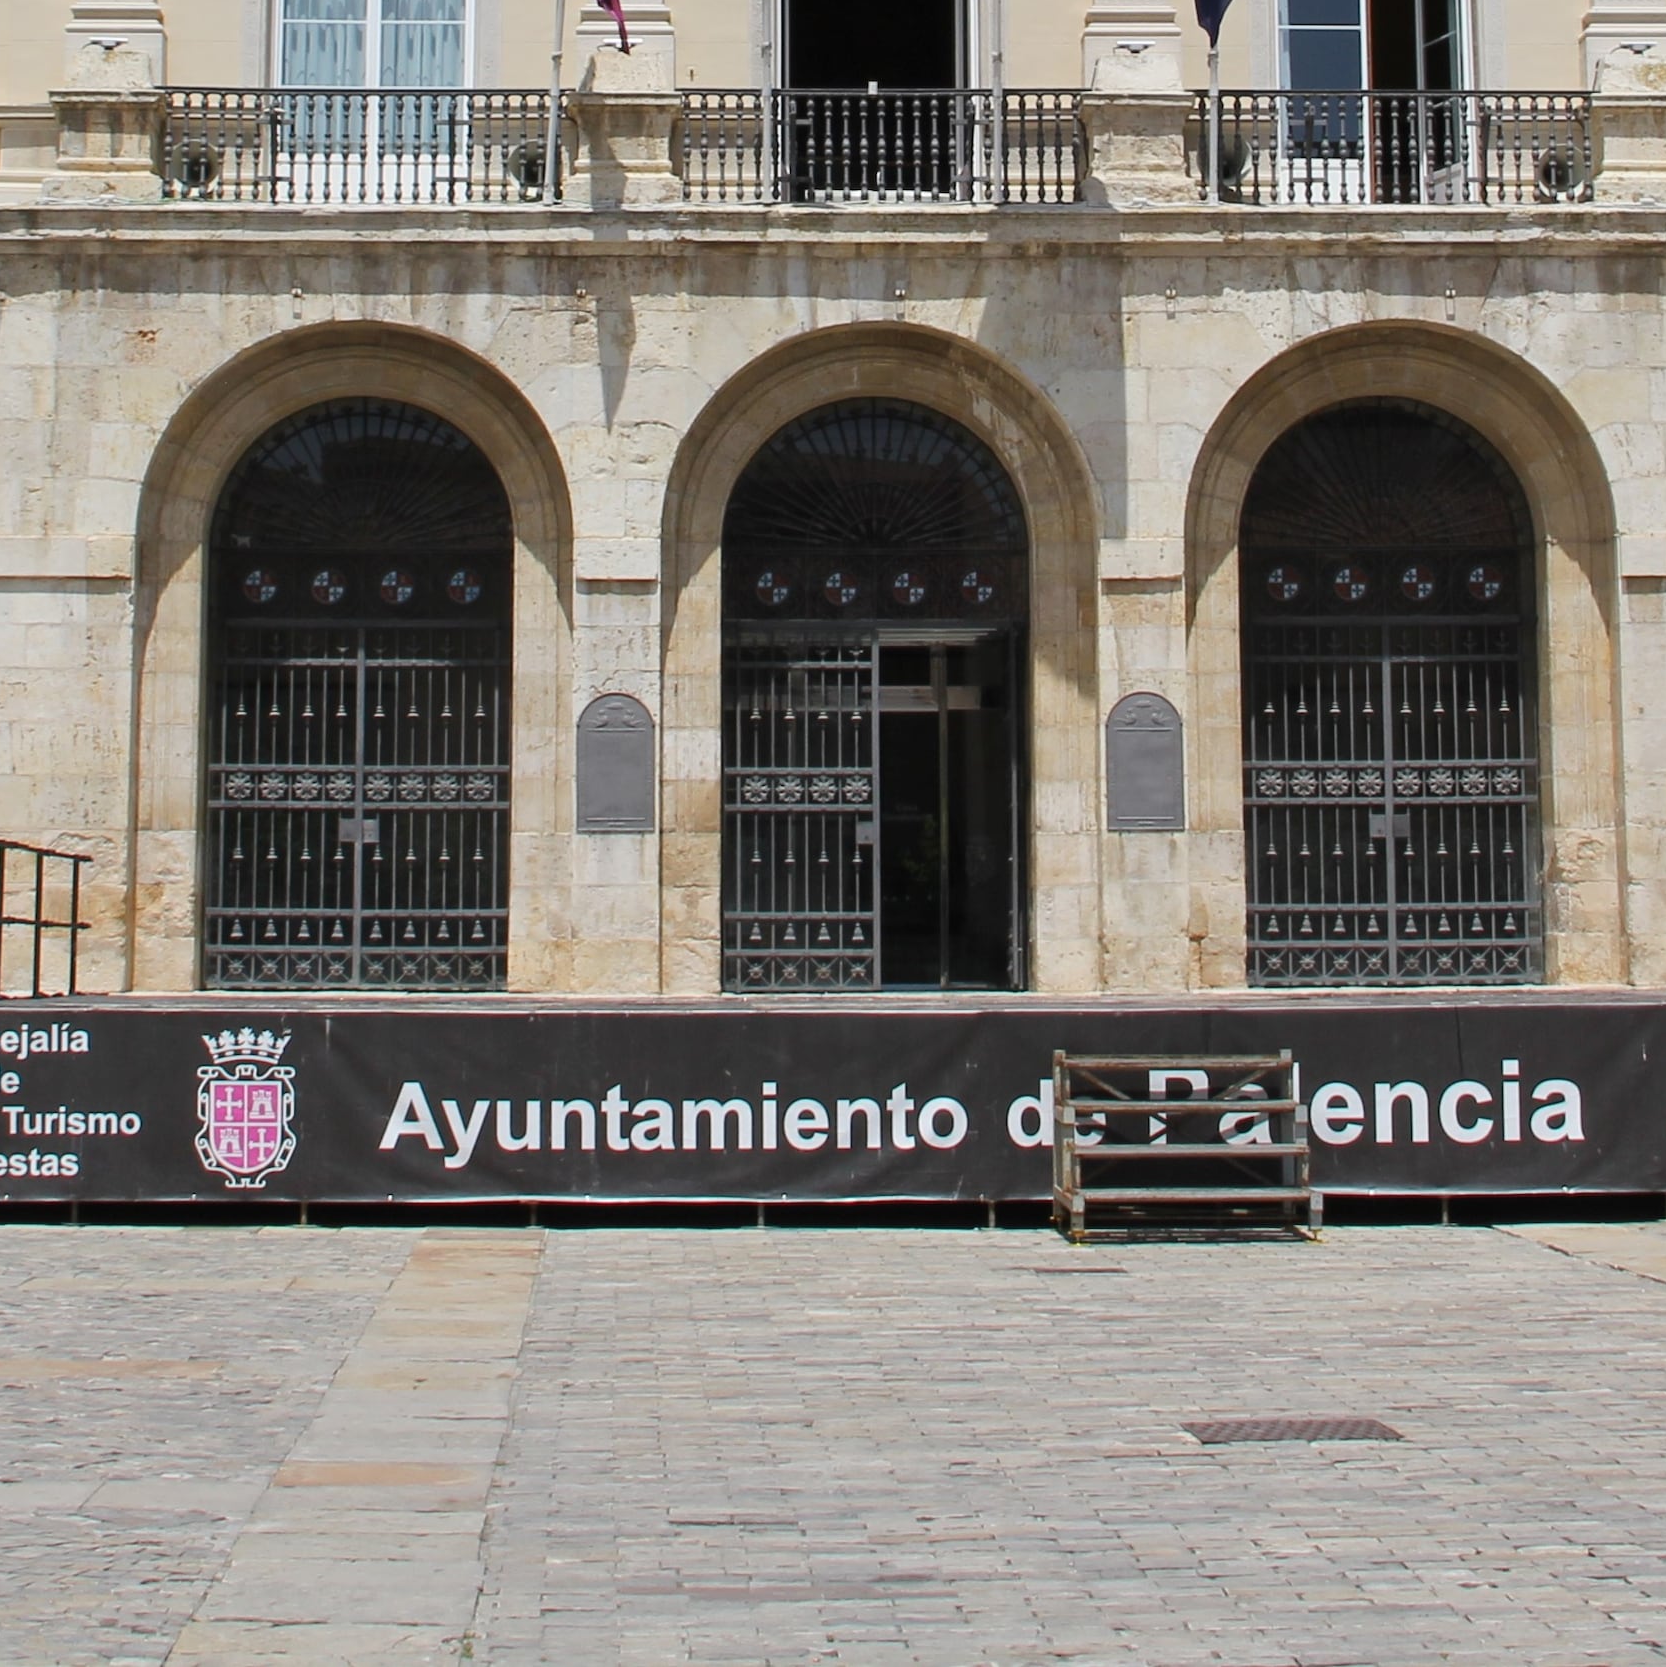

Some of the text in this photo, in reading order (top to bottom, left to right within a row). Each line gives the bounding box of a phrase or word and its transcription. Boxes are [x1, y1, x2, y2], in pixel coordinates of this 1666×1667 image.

[1, 1106, 141, 1135] Turismo
[379, 1081, 968, 1169] Ayuntamiento
[1148, 1059, 1585, 1148] Paencia
